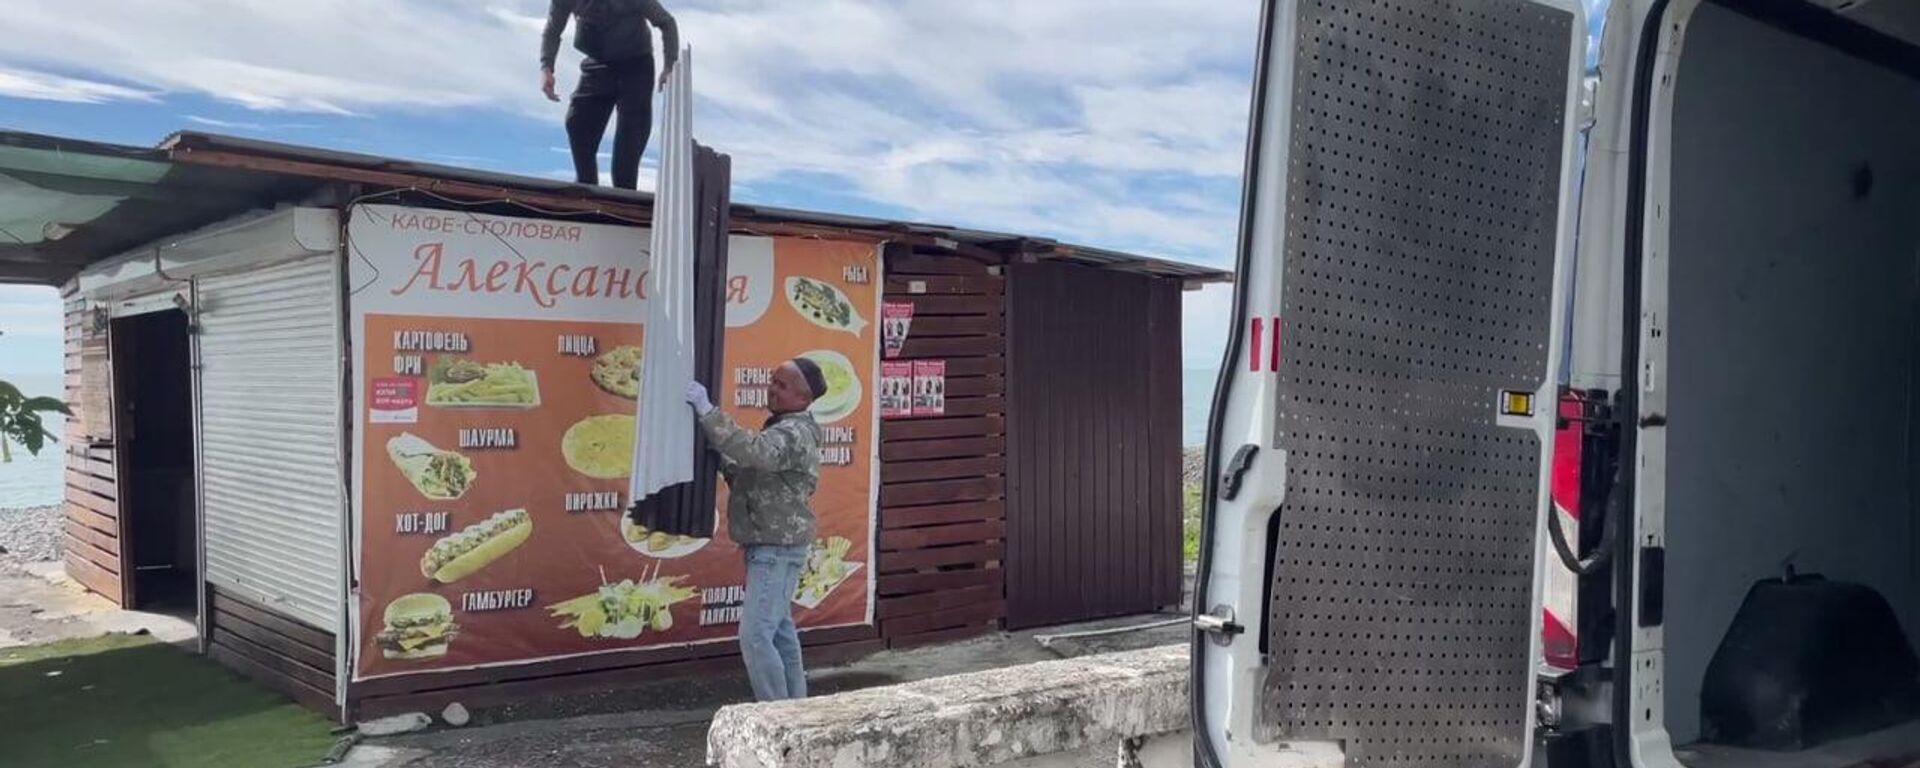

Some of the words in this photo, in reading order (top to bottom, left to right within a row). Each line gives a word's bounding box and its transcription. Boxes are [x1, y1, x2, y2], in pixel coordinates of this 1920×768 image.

[392, 213, 582, 242] КАФЕ-СТОЛОВАЯ
[390, 242, 749, 308] Алексаня
[843, 265, 867, 282] РЫБА
[393, 331, 468, 351] КАРТОФЕЛЬ
[558, 334, 595, 356] ПИЦЦА
[394, 355, 422, 374] ФРИ
[734, 367, 772, 384] ПЕРВЫЕ
[459, 428, 515, 448] ШАУРМА
[820, 426, 853, 443] ТОРЫЕ
[565, 491, 618, 511] ПИРОЖКИ
[396, 511, 448, 534] ХОТ-ДОГ
[462, 588, 533, 612] ГАМБУРГЕР
